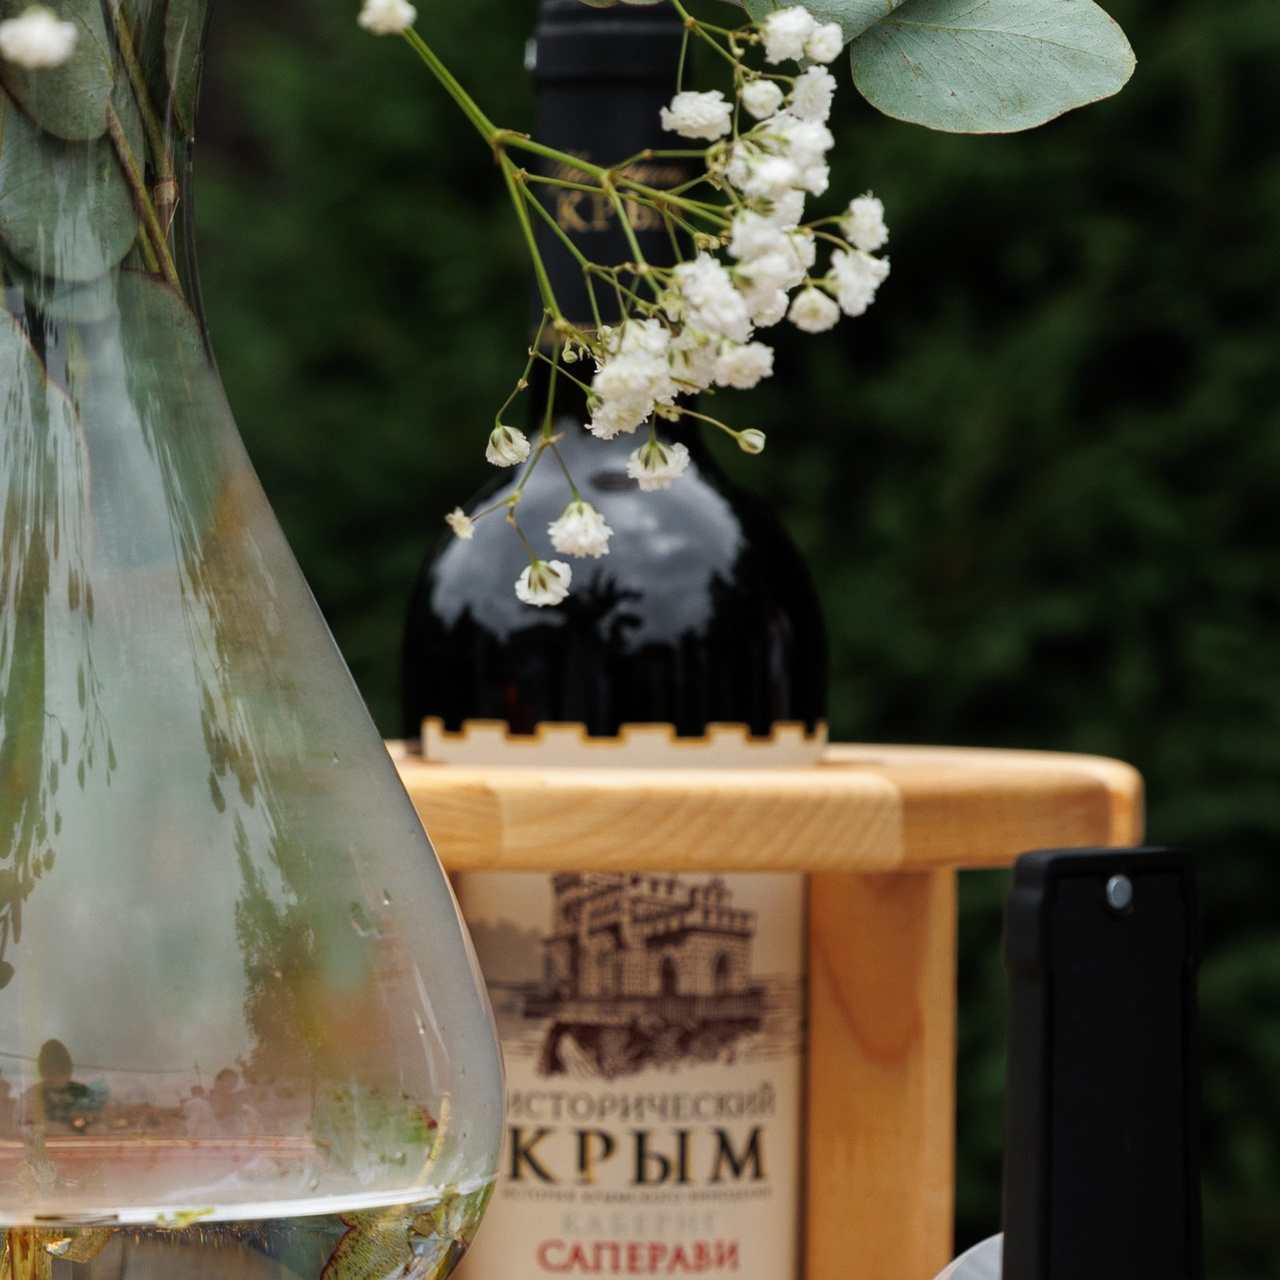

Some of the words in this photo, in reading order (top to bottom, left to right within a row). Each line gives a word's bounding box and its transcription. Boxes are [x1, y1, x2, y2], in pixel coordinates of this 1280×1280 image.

[506, 1082, 775, 1119] ИСТОРИЧЕСКИЙ
[508, 1124, 765, 1186] КРЫМ
[536, 1238, 740, 1275] САПЕРАВИ
